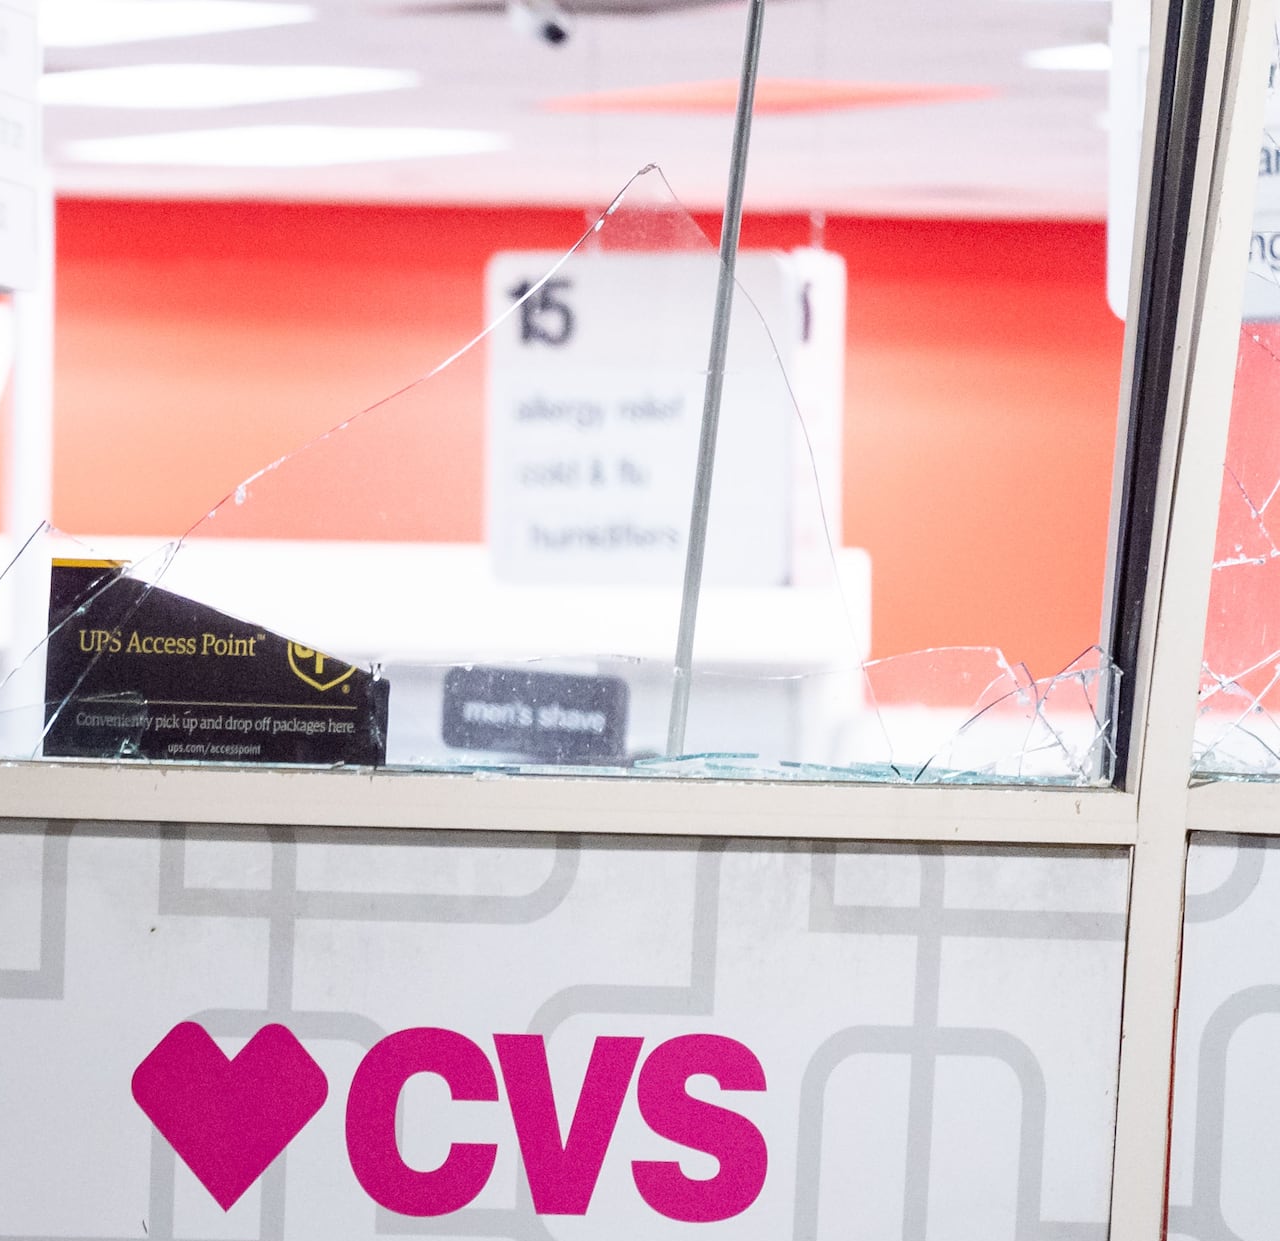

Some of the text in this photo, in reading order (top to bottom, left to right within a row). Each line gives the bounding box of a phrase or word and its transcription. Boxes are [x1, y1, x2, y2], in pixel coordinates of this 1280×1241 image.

[506, 275, 576, 347] 15
[79, 630, 122, 653] UPS
[126, 633, 197, 656] Access
[155, 715, 180, 734] pick
[182, 718, 198, 735] up
[200, 715, 224, 732] and
[225, 716, 253, 735] drop
[254, 716, 271, 732] off
[273, 716, 326, 738] packages
[345, 1026, 768, 1223] CVS
